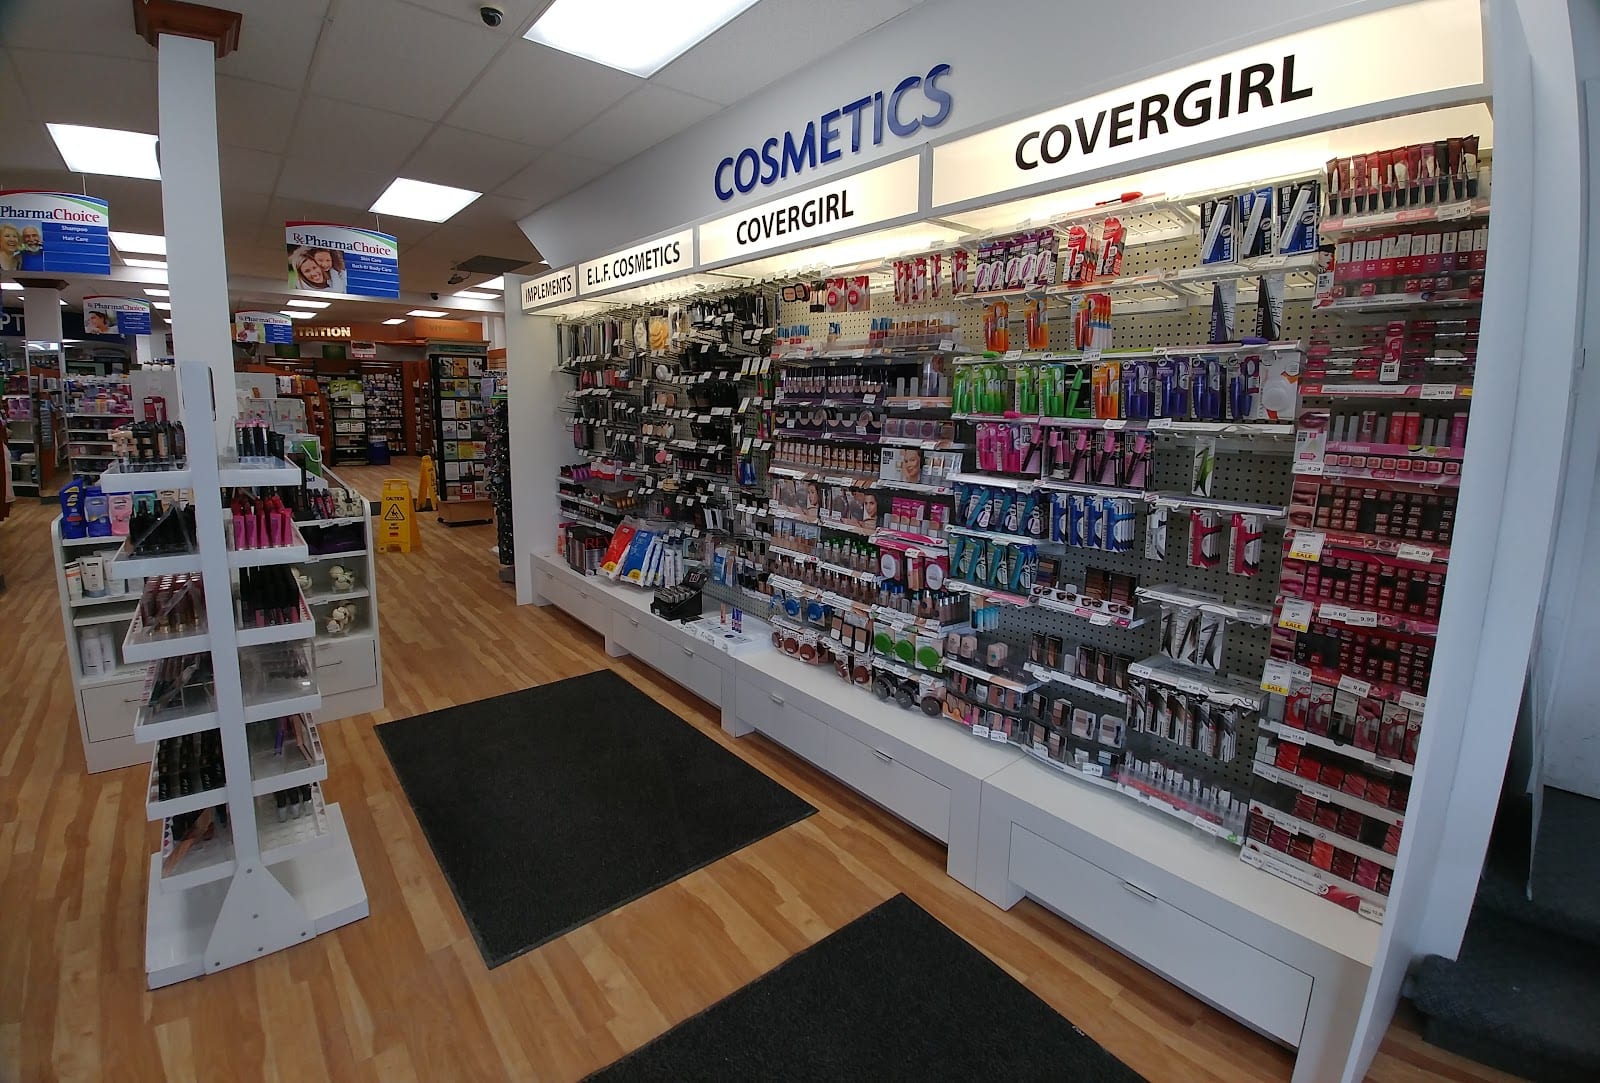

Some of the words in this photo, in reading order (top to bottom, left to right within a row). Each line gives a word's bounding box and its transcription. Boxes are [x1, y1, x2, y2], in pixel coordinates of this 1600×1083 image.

[1015, 54, 1313, 171] COVERGIRL
[714, 63, 953, 201] COSMETICS
[0, 205, 100, 223] PharmaChoice
[736, 189, 854, 245] COVERGIRL
[61, 225, 89, 233] Shampoo
[305, 234, 391, 256] PharmaChoice
[587, 263, 611, 286] E.L.F.
[613, 241, 680, 279] COSMETICS
[525, 274, 572, 303] IMPLEMENTS
[295, 326, 351, 337] TRITION
[1285, 621, 1302, 629] SALE
